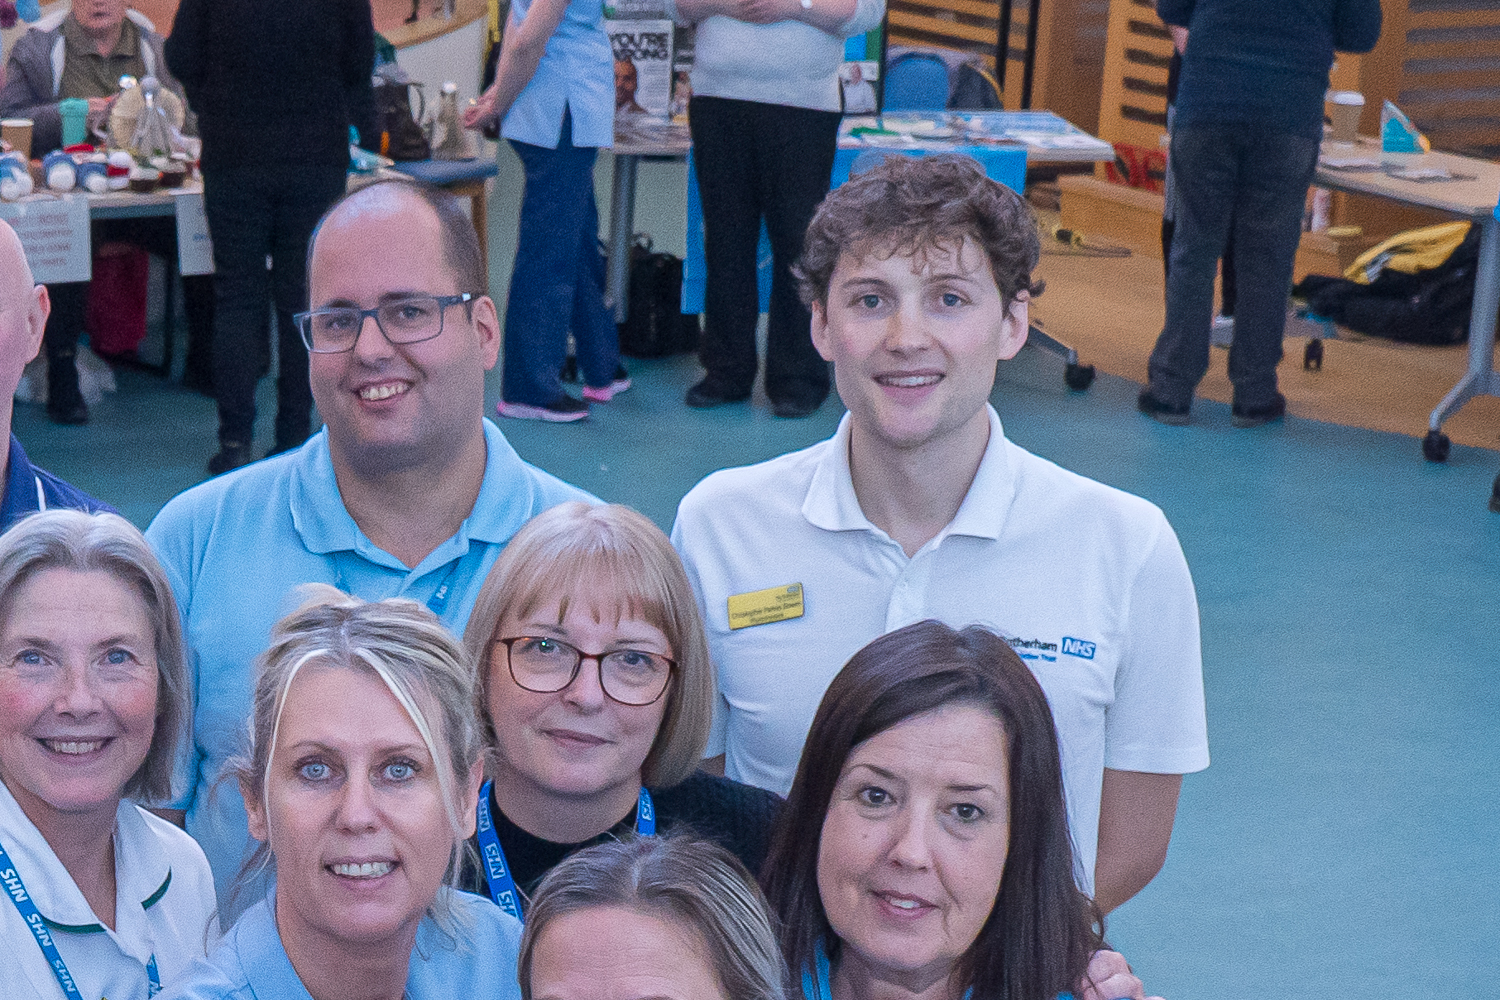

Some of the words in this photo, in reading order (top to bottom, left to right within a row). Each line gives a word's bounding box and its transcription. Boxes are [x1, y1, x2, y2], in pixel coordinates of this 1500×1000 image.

[1064, 638, 1094, 657] NHS
[487, 846, 505, 877] NHS
[0, 868, 29, 903] NHS
[501, 893, 517, 917] HS
[27, 913, 52, 947] NHS
[53, 959, 76, 992] NHS
